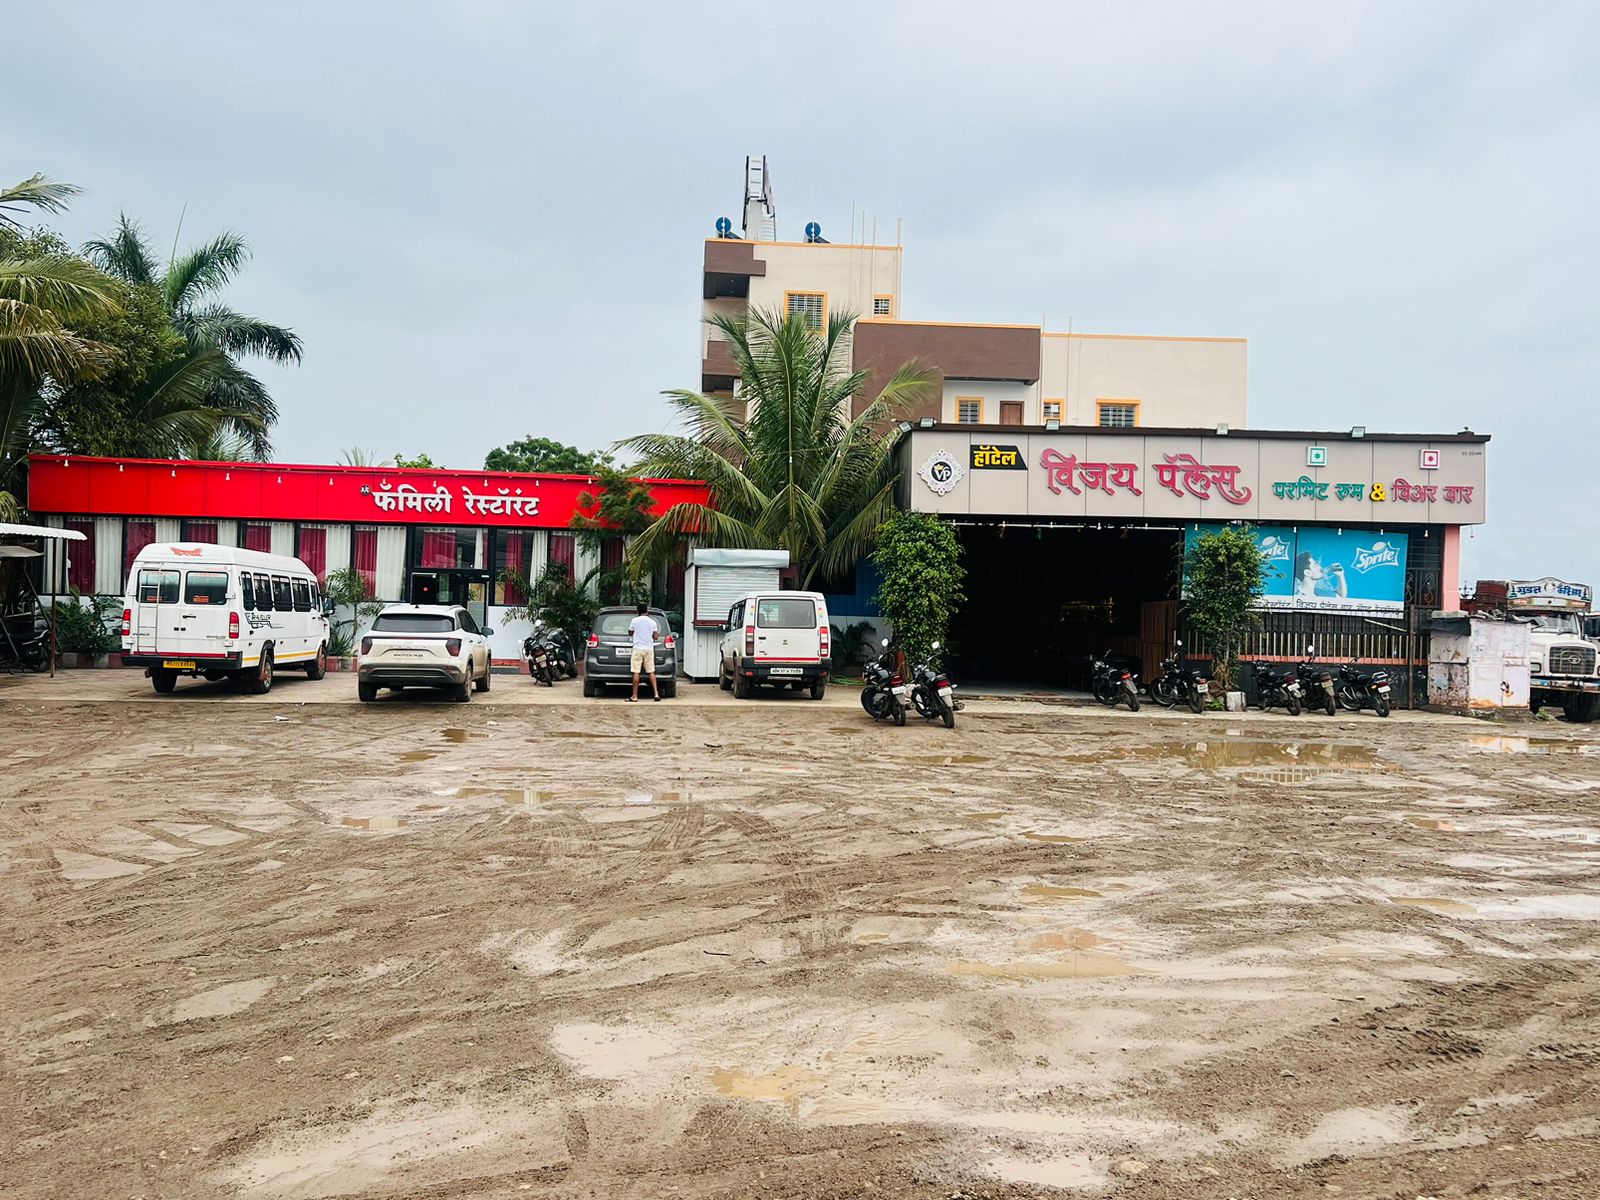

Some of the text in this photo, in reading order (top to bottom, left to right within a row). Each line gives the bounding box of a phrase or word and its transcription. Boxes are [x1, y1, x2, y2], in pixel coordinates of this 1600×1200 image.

[973, 445, 1017, 467] हॉटेल
[1040, 447, 1252, 505] विजय पॅलेस
[1272, 475, 1329, 501] परमिट
[1370, 483, 1387, 502] &
[372, 483, 453, 514] फॅमिली
[461, 485, 540, 517] रेस्टॉरंट
[1356, 548, 1395, 569] Sprite
